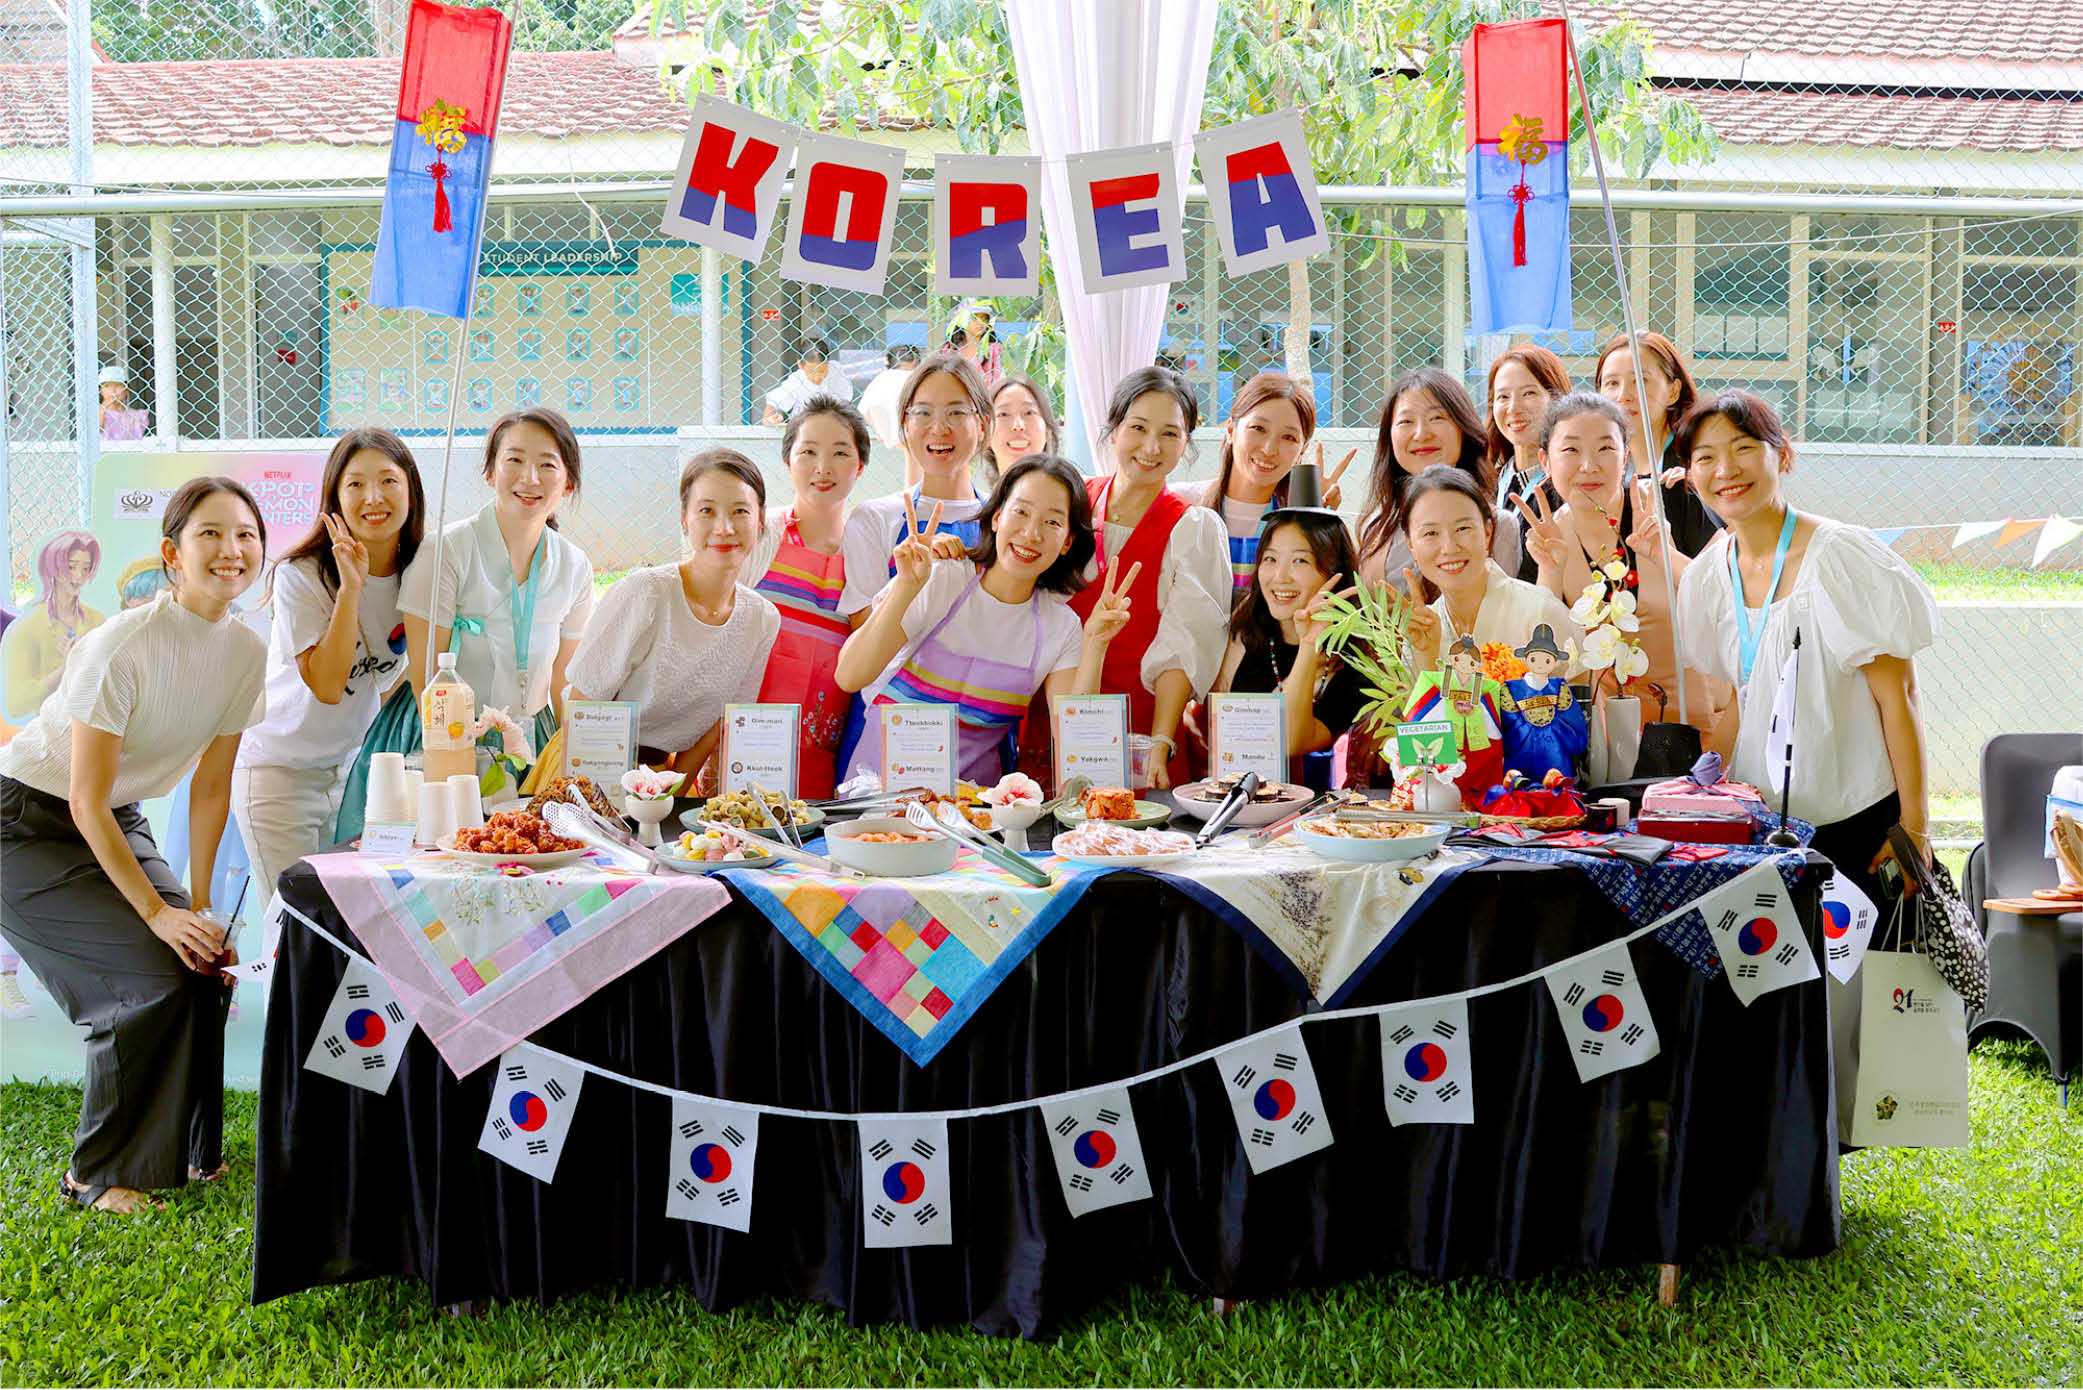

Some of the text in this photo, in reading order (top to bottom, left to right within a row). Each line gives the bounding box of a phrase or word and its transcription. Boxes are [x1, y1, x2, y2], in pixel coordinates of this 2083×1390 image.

[679, 120, 1317, 280] KOREA
[483, 251, 623, 264] STUDENT LEADERSHIP
[264, 471, 292, 479] NETFLIX
[255, 496, 315, 512] EMON
[263, 511, 314, 525] NTERS
[1399, 724, 1448, 734] VEGETARIAN
